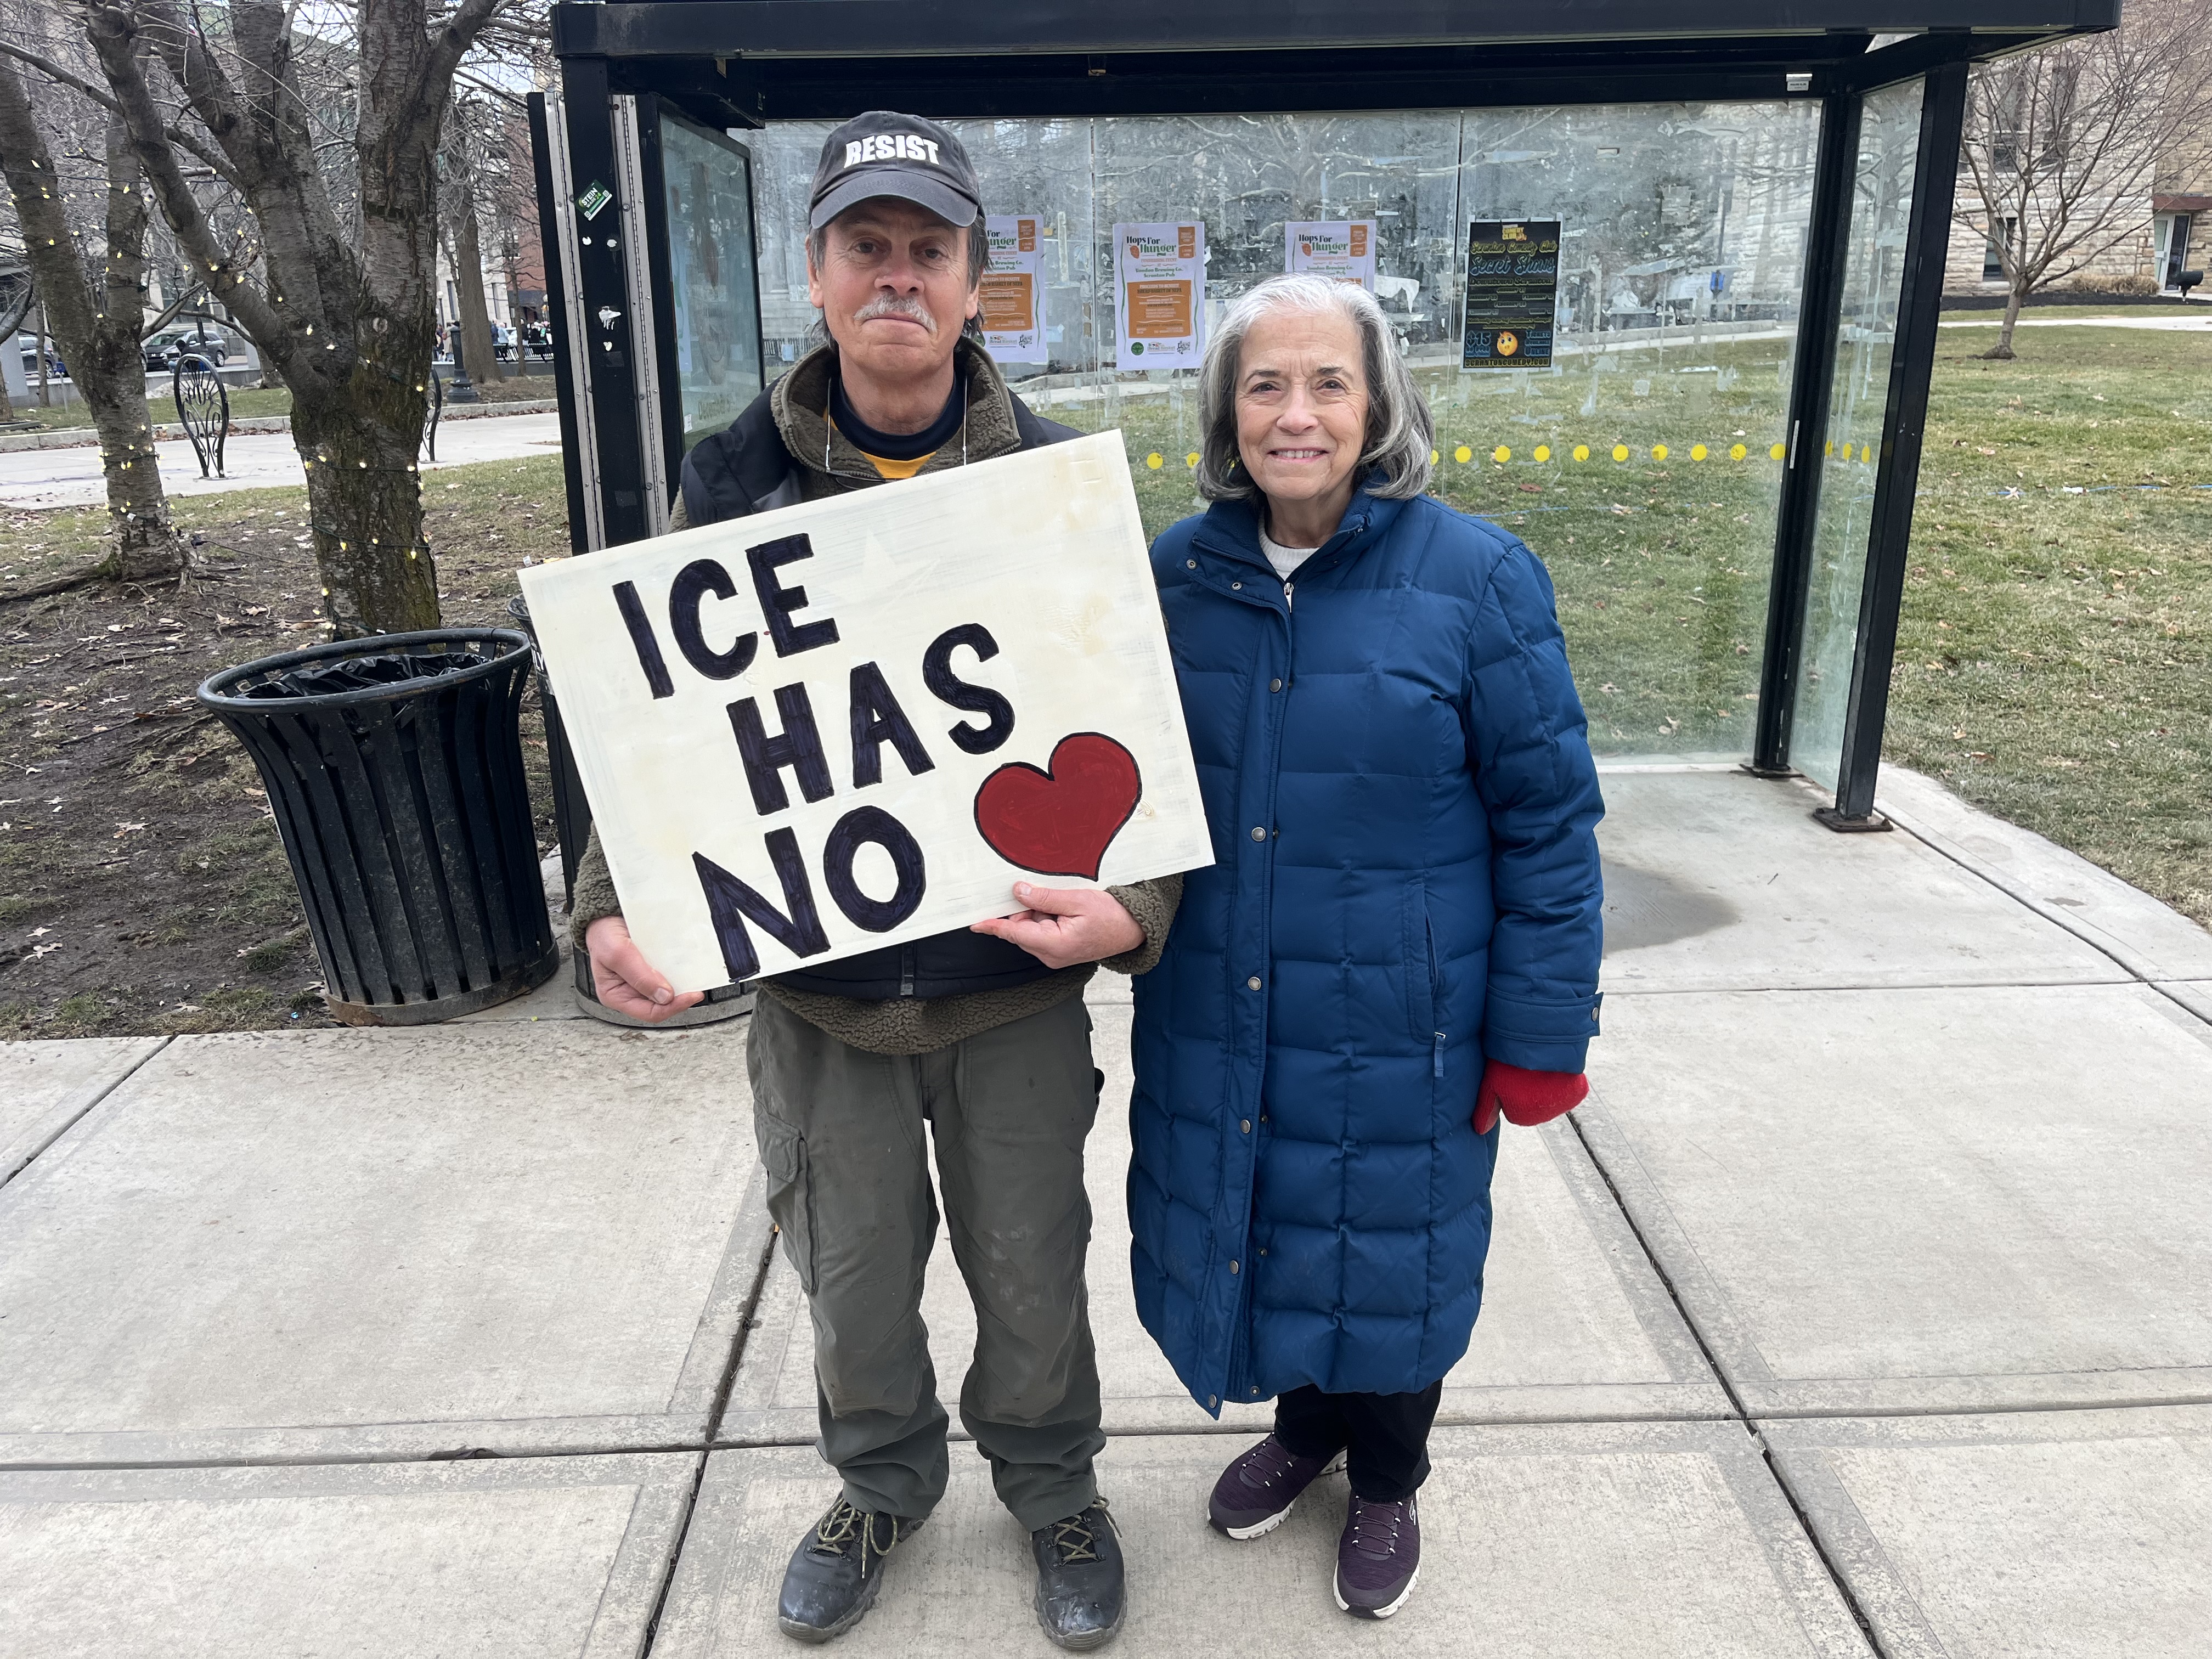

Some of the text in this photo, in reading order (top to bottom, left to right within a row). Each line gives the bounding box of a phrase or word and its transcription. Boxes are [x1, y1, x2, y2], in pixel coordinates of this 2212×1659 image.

[844, 135, 939, 168] RESIST
[582, 187, 598, 206] STEIN
[989, 236, 1017, 250] unger
[1126, 236, 1161, 246] Hops For
[1299, 234, 1318, 244] Hops
[1140, 244, 1177, 257] Hunger
[1312, 242, 1348, 255] Hunger
[1470, 240, 1558, 257] Scranton Comedy Club
[1469, 254, 1555, 276] Secret Shows
[1466, 329, 1551, 347] $15 TICKETS
[612, 533, 840, 699] ICE
[726, 623, 1015, 816] HAS
[692, 805, 926, 984] NO
